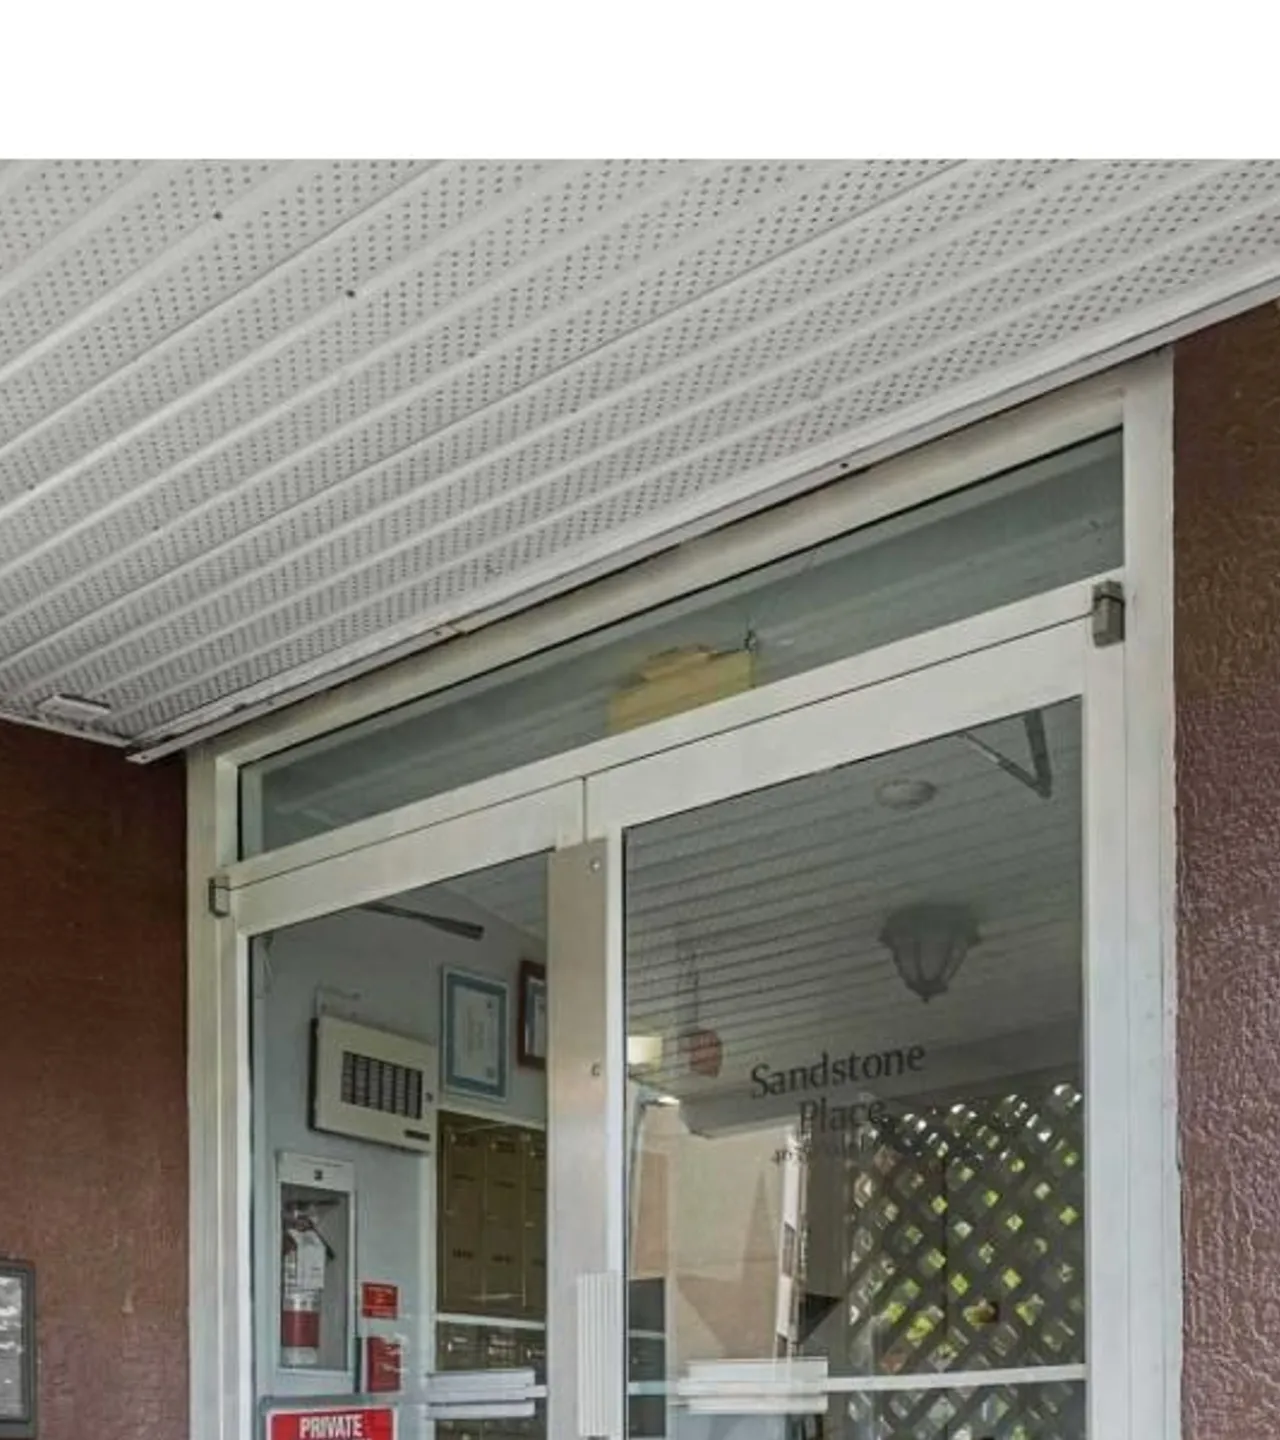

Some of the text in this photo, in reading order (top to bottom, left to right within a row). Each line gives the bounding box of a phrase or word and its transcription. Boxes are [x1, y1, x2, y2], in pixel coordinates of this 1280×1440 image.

[750, 1043, 926, 1099] Sandstone
[799, 1096, 888, 1136] Place
[299, 1414, 364, 1439] PRIVATE
